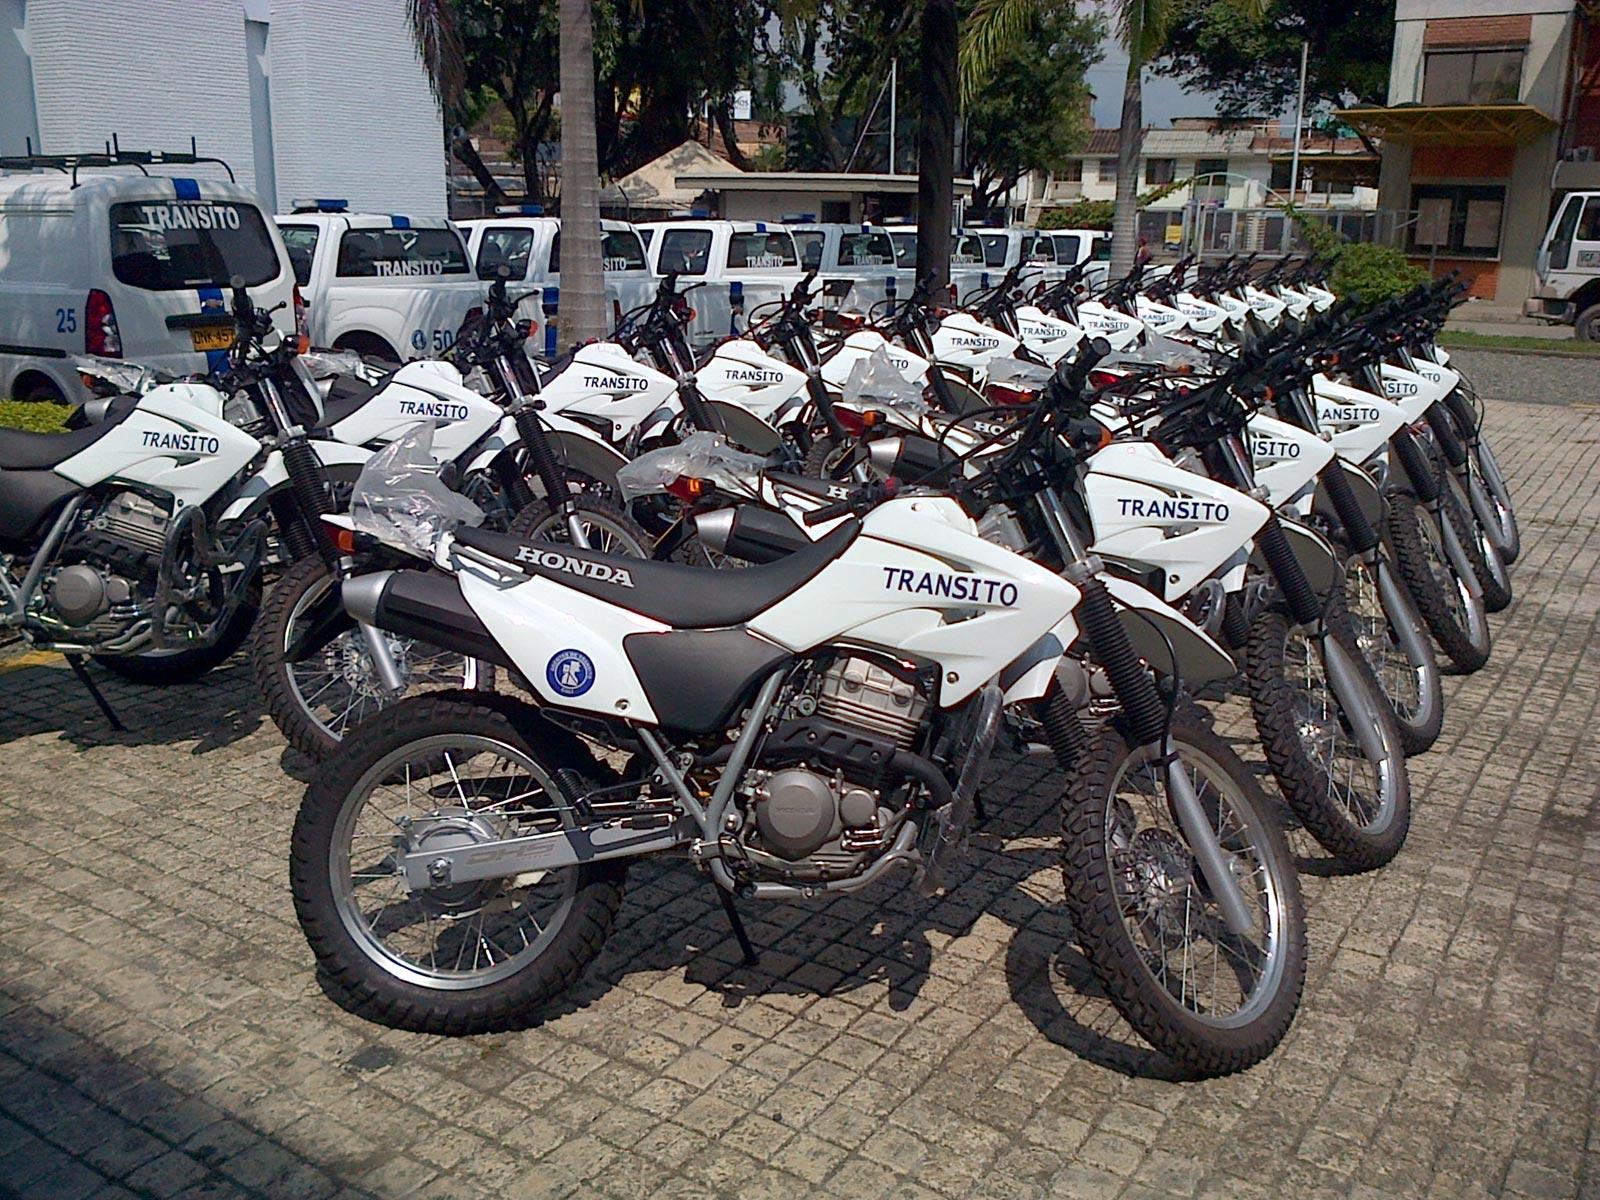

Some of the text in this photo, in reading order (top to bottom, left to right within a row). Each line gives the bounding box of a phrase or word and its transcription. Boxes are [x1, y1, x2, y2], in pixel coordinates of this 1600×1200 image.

[142, 205, 240, 230] TRANSITO
[374, 260, 443, 276] TRANSITO
[603, 257, 627, 271] SITO
[746, 255, 783, 268] TRANSITO
[56, 308, 77, 334] 25
[1088, 321, 1130, 330] TRANSITO
[1022, 327, 1068, 337] TRANSITO
[433, 330, 453, 351] 50
[950, 337, 1000, 348] TRANSITO
[584, 376, 649, 391] TRANSITO
[725, 369, 784, 383] TRANSITO
[1386, 382, 1418, 395] SITO
[400, 401, 469, 420] TRANSITO
[1321, 407, 1380, 421] ANSITO
[142, 431, 220, 454] TRANSITO
[1253, 440, 1300, 458] SITO
[1117, 499, 1229, 521] TRANSITO
[515, 545, 635, 588] HONDA
[883, 567, 1018, 607] TRANSITO
